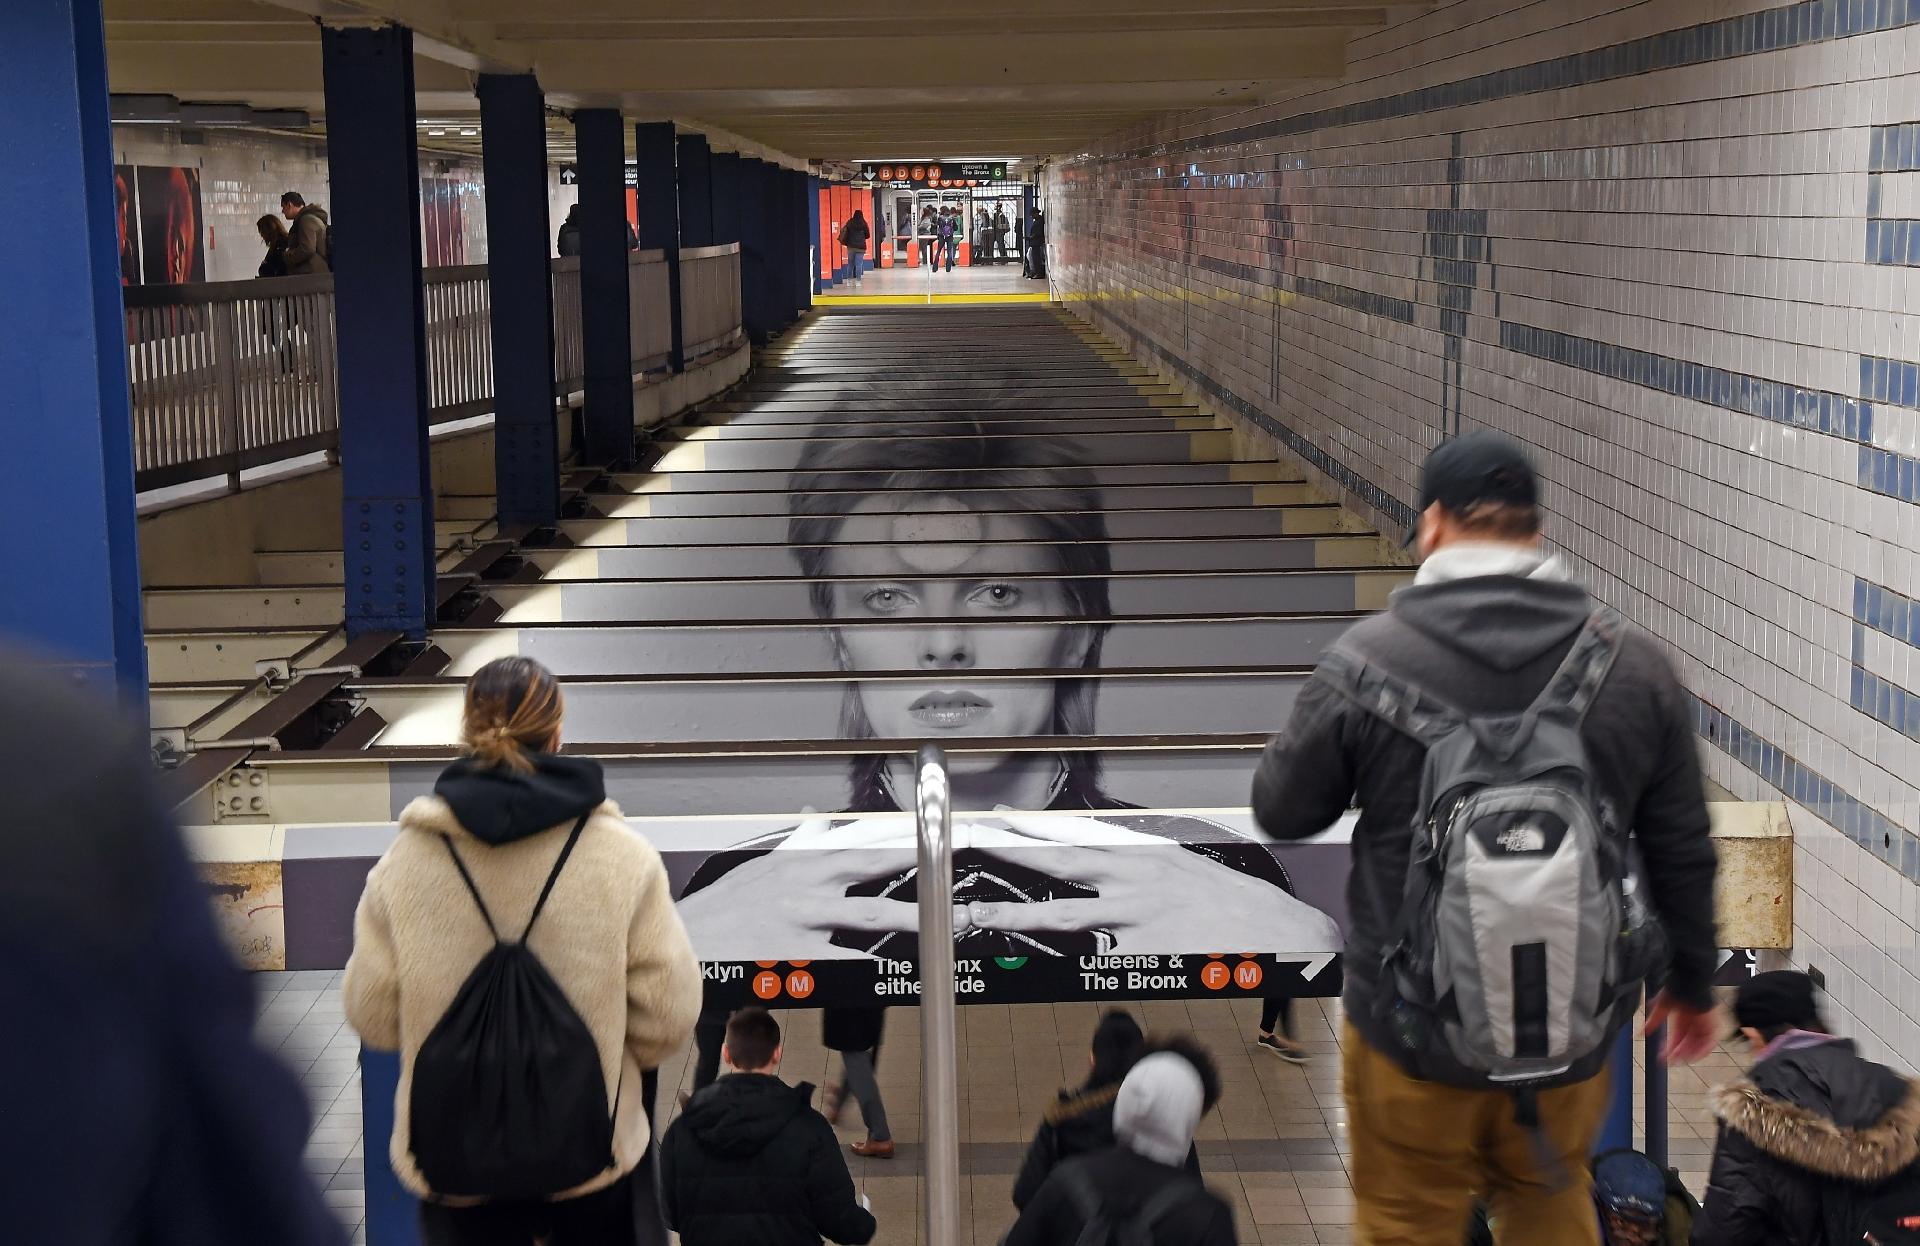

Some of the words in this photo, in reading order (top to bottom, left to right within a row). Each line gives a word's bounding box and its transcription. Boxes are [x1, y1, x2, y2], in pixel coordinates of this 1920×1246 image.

[873, 958, 913, 975] The
[1079, 955, 1160, 970] Queens
[1168, 954, 1184, 969] &
[701, 961, 744, 983] klyn
[1079, 972, 1119, 990] The
[1127, 971, 1188, 990] Bronx
[1209, 967, 1222, 984] F
[1239, 967, 1257, 983] M
[761, 976, 774, 993] F
[791, 976, 809, 992] M
[874, 976, 922, 995] eithe
[954, 975, 986, 993] ide
